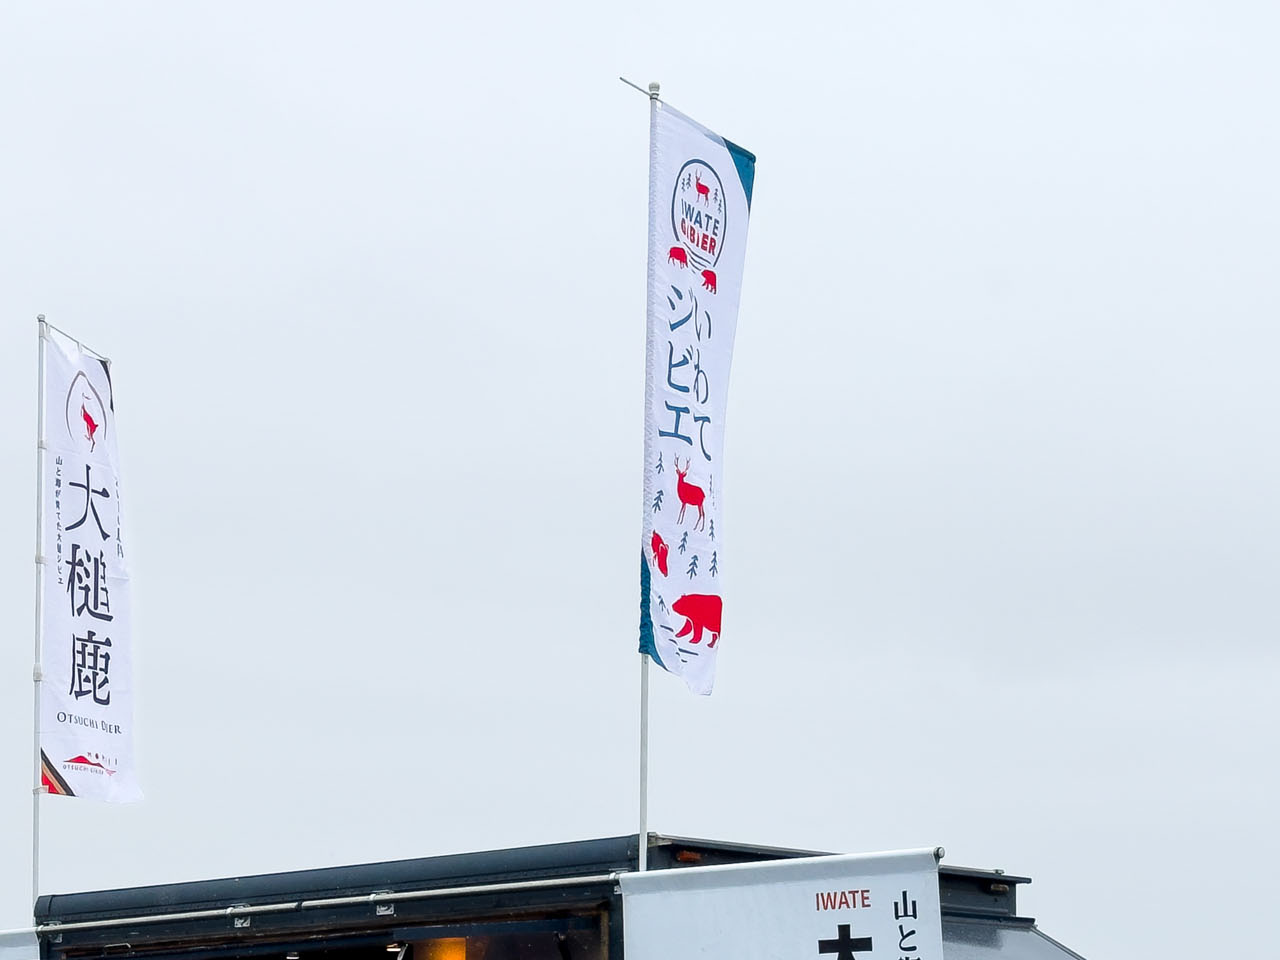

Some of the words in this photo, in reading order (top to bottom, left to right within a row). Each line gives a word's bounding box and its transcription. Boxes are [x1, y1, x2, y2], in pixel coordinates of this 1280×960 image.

[680, 198, 720, 237] IWATE
[680, 217, 717, 256] GIBIER
[658, 284, 694, 446] ジビエ
[65, 463, 115, 706] 大槌鹿
[816, 889, 872, 911] IWATE
